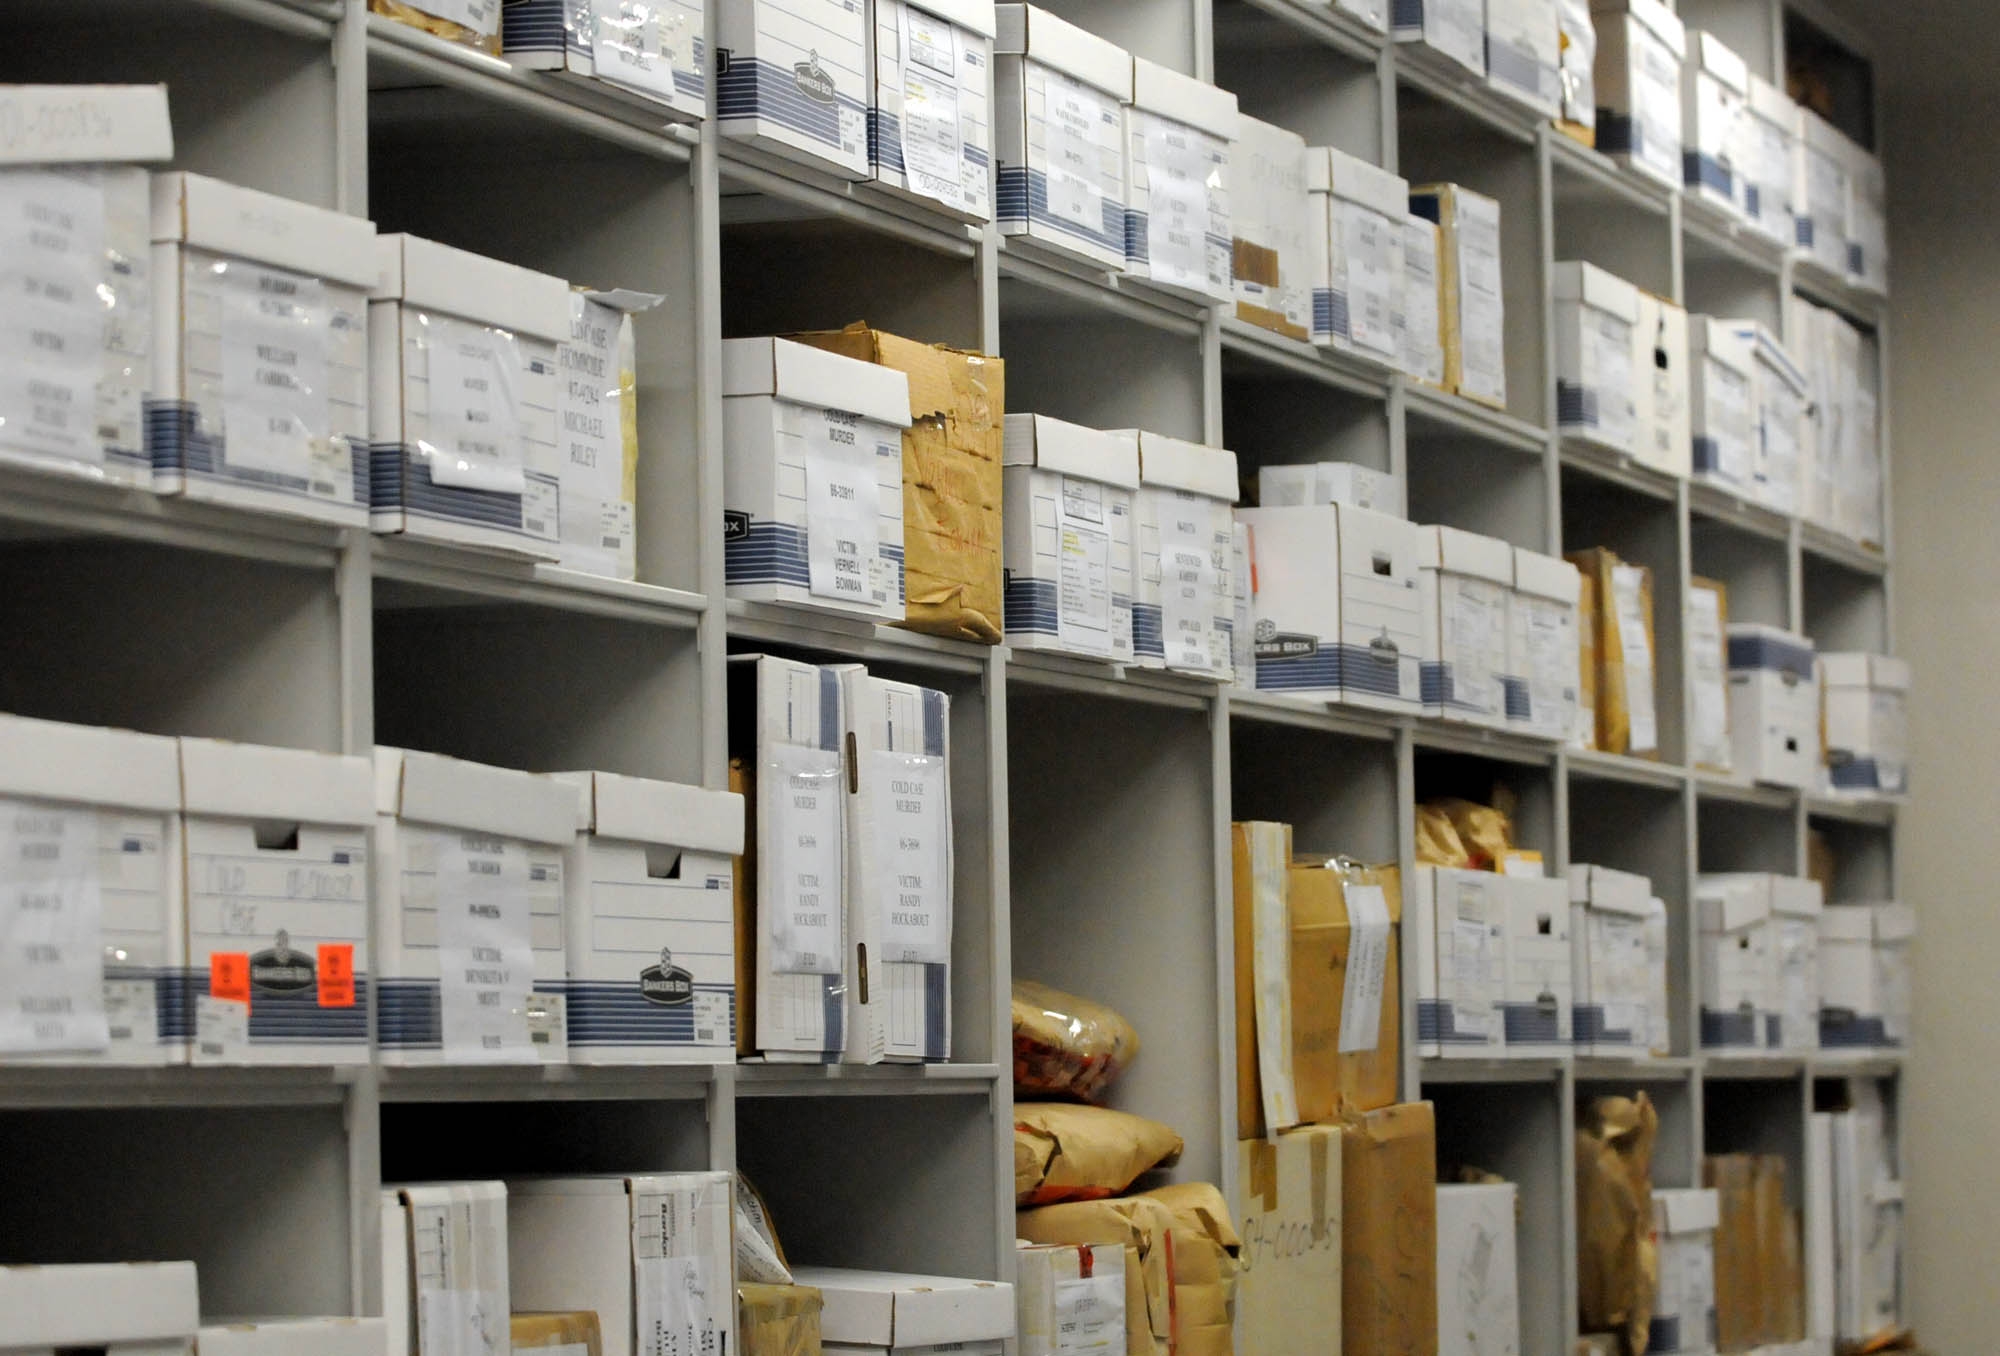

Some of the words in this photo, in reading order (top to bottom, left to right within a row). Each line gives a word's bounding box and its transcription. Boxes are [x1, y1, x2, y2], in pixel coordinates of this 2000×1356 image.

[796, 71, 821, 92] BANKERS
[821, 81, 833, 97] BOX
[829, 427, 856, 446] MURDER
[570, 442, 598, 469] RILEY
[834, 558, 861, 575] VERNELL
[835, 576, 863, 593] BOWMAN
[1283, 641, 1311, 651] BOX
[891, 780, 909, 794] COLD
[643, 978, 675, 992] BANKERS
[676, 980, 690, 993] BOX
